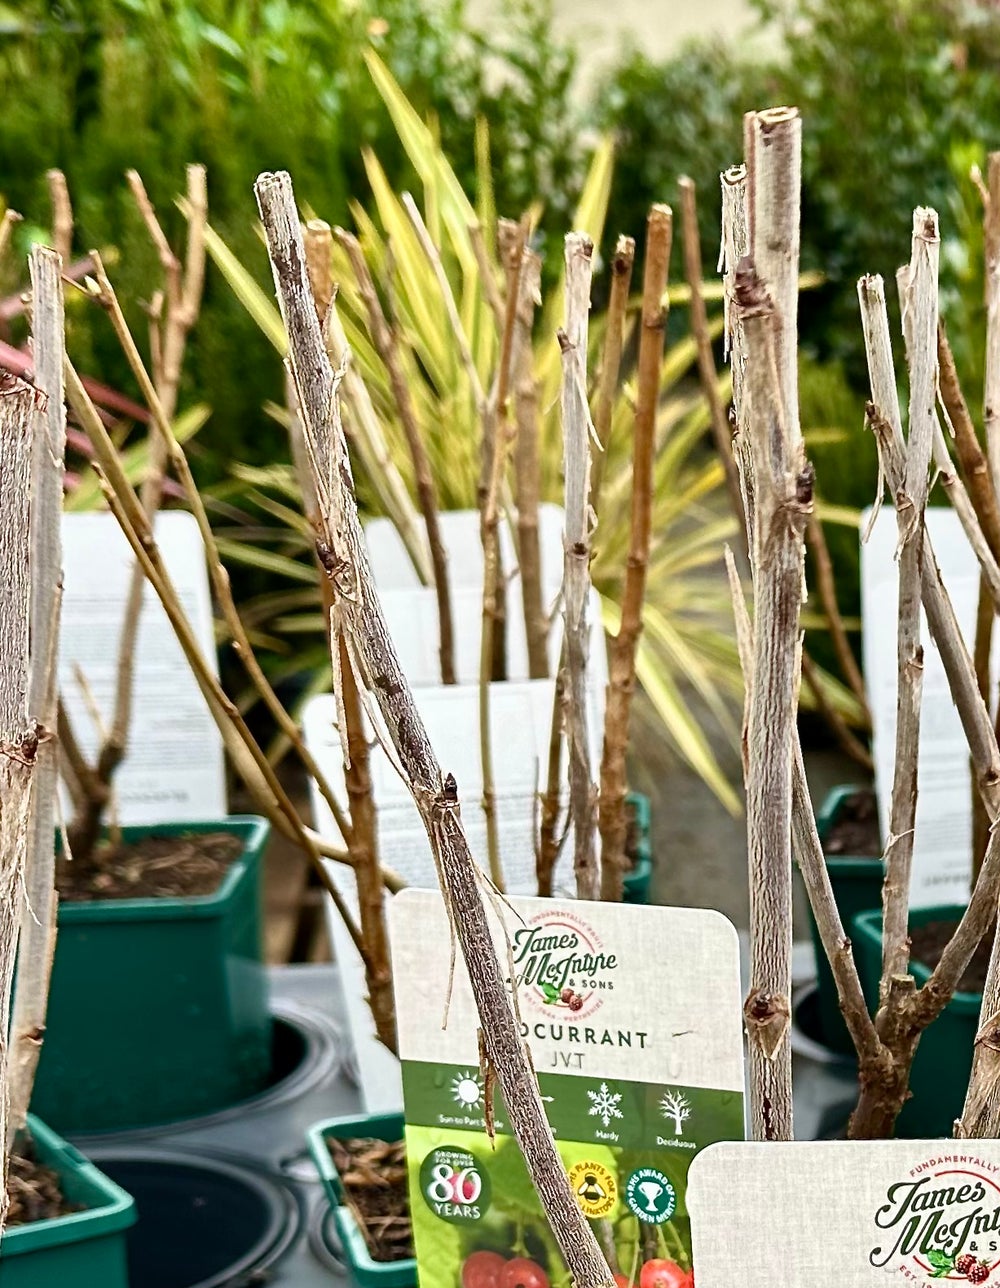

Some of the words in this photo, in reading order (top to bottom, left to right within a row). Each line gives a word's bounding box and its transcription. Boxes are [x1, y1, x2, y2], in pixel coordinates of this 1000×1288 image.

[512, 926, 578, 963] James
[506, 953, 618, 993] McIntyre
[582, 979, 614, 990] SONS
[520, 1023, 648, 1049] DCURRANT
[551, 1051, 586, 1069] JVT
[595, 1130, 619, 1141] Hardy
[656, 1136, 697, 1149] Deciduous
[575, 1162, 605, 1175] PLANTS
[605, 1174, 615, 1192] FOR
[909, 1155, 999, 1177] FUNDAMENTALLY
[427, 1164, 482, 1204] 80
[628, 1174, 640, 1191] RHS
[639, 1169, 668, 1187] AWARD
[665, 1185, 676, 1197] OF
[435, 1203, 481, 1219] YEARS
[629, 1197, 655, 1223] GARDEN
[656, 1201, 675, 1222] MERIT
[875, 1177, 986, 1229] James
[969, 1241, 978, 1251] &
